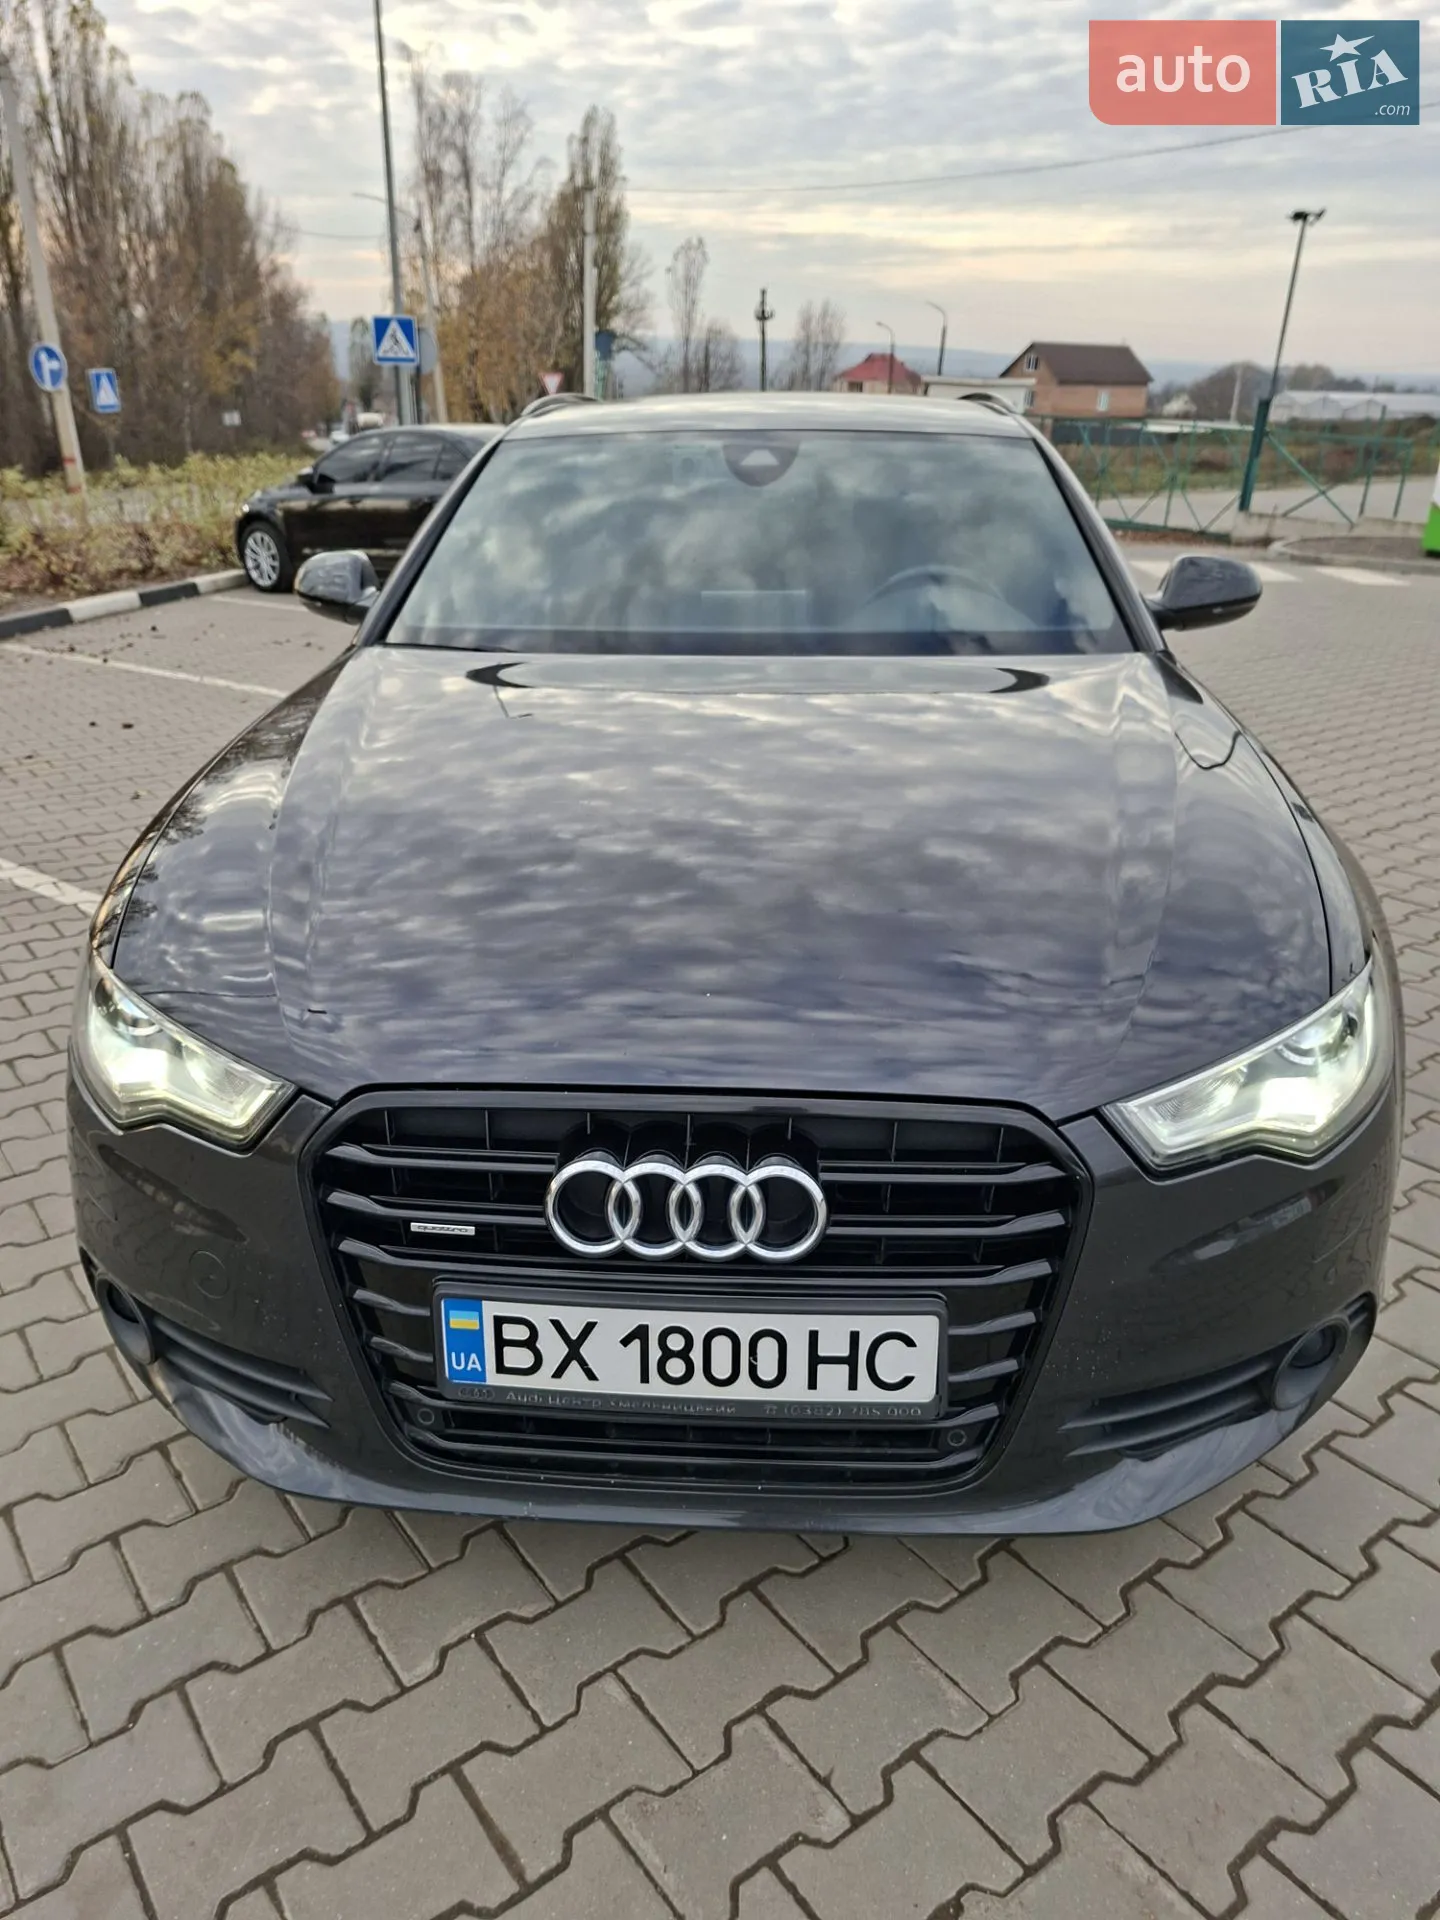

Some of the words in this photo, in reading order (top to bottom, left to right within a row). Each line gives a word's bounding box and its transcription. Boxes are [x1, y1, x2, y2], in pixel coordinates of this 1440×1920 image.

[451, 1352, 483, 1372] UA
[492, 1315, 600, 1382] BX
[618, 1323, 788, 1390] 1800
[807, 1329, 918, 1393] HC
